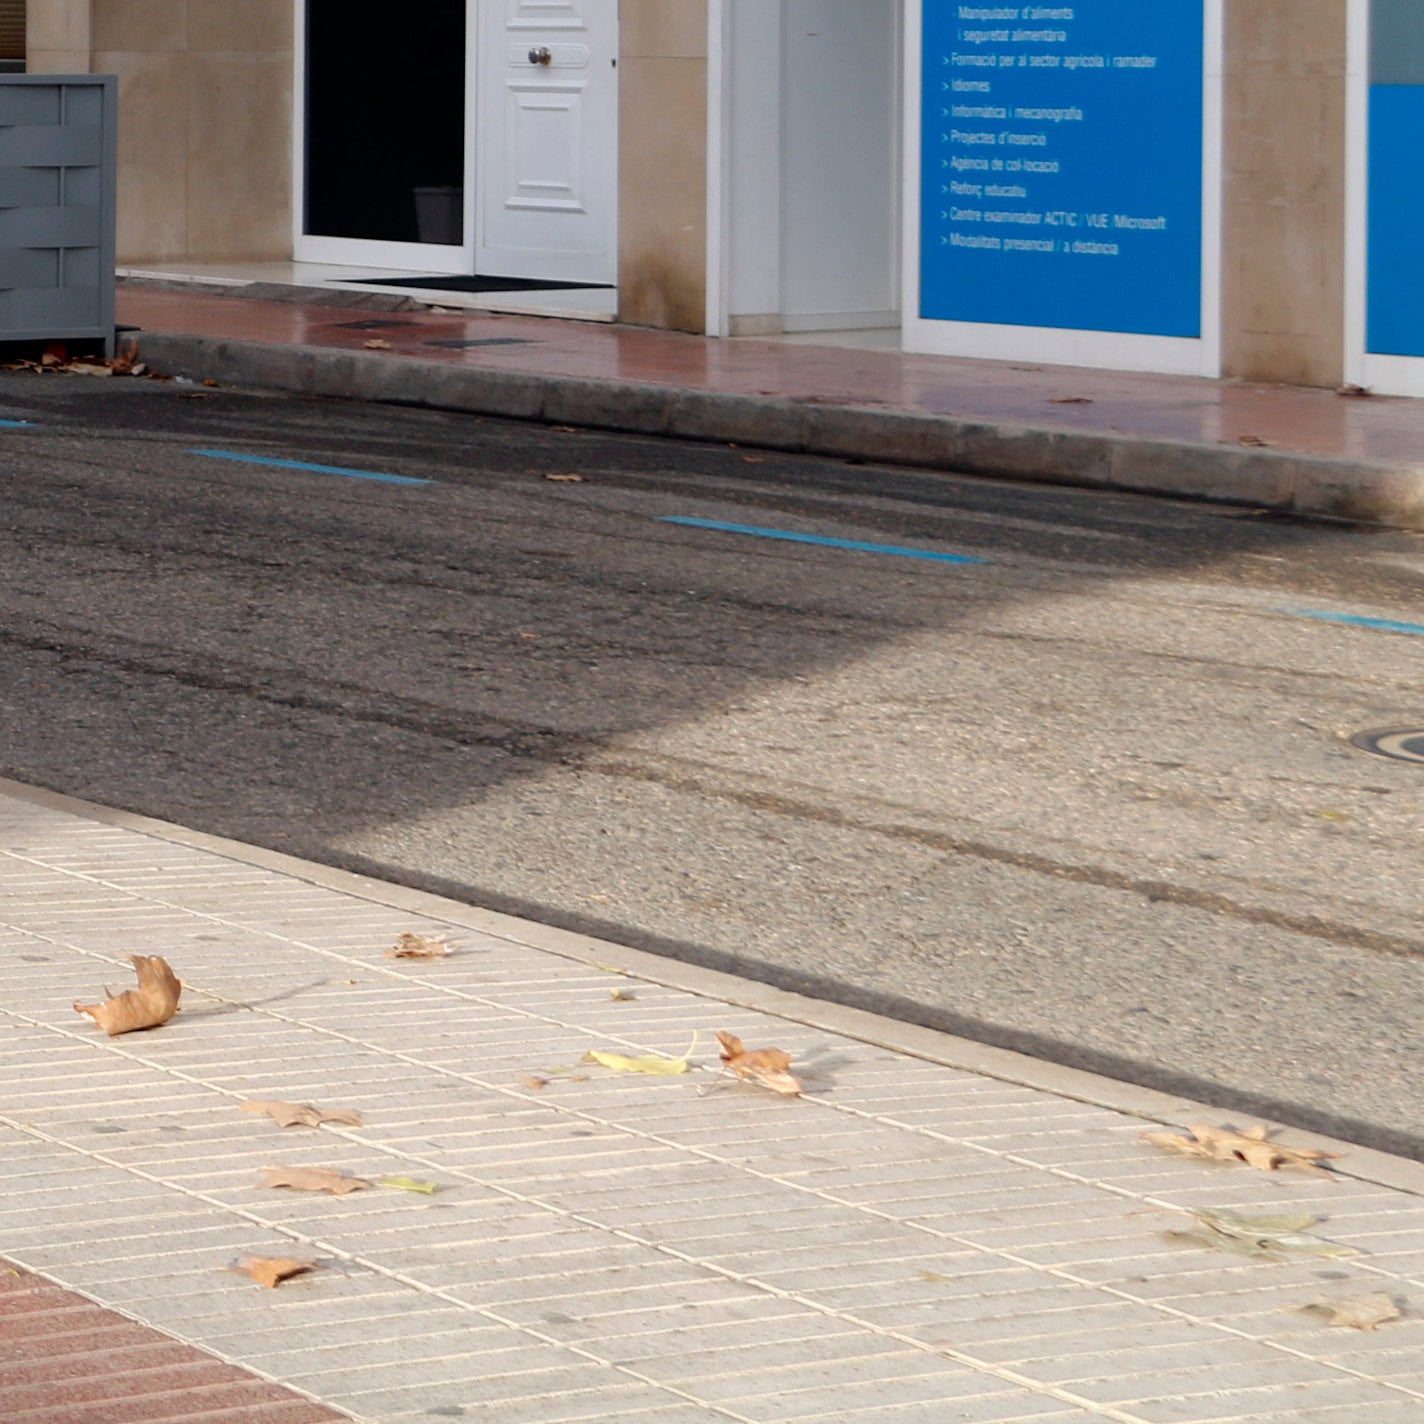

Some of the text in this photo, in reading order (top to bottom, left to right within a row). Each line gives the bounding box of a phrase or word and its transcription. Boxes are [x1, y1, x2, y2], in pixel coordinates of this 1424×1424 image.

[958, 6, 1019, 21] Manipulador
[963, 29, 1009, 44] seguretat
[952, 51, 997, 66] Formació
[999, 55, 1014, 68] per
[1029, 54, 1060, 66] sector
[1112, 53, 1156, 68] ramader
[952, 78, 991, 92] Idiomes
[951, 129, 995, 146] Projectes
[991, 158, 1003, 171] de
[984, 183, 1027, 198] educatiu
[950, 207, 981, 222] Centre
[983, 210, 1041, 225] examinador
[1044, 211, 1077, 227] ACTIC
[1113, 214, 1166, 230] Microsoft
[950, 232, 1001, 249] Modalitats
[1003, 238, 1055, 253] presencial
